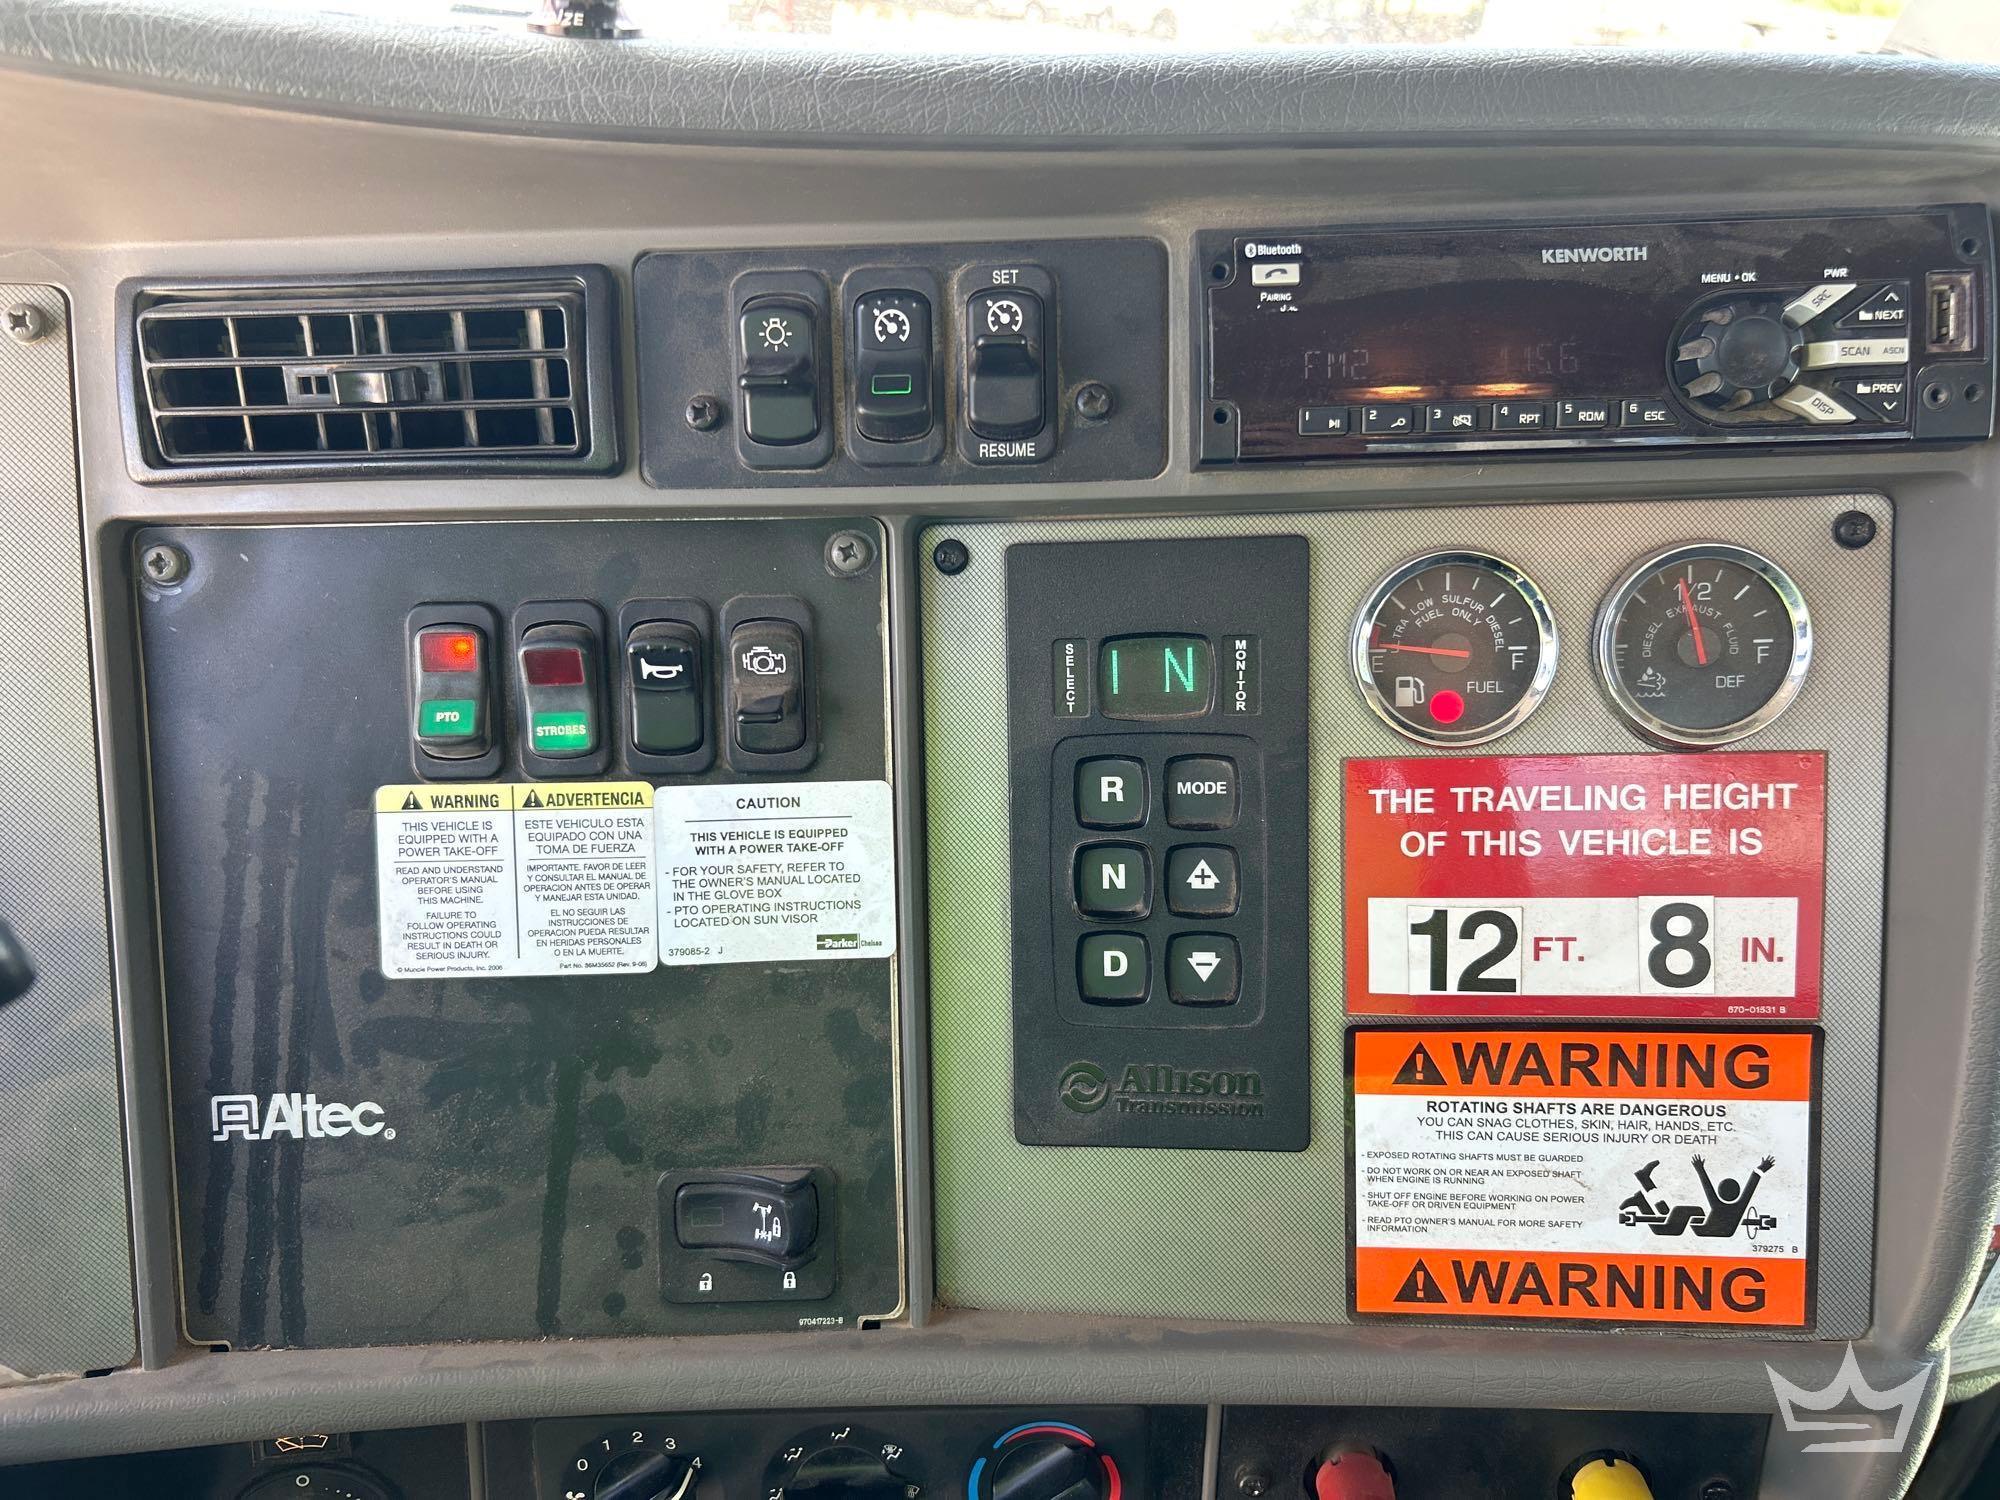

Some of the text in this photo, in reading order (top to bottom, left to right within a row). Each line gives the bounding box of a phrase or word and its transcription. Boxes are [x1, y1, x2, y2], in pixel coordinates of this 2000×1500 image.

[1257, 244, 1302, 256] Bluetooth
[1541, 247, 1648, 264] KENWORTH
[992, 269, 1019, 284] SET
[1701, 272, 1756, 284] MENU OK
[1823, 268, 1849, 278] PWR
[1811, 289, 1832, 308] SRC
[1874, 309, 1905, 320] NEXT
[1840, 347, 1871, 356] SCAN
[1304, 350, 1369, 380] FM2
[1872, 383, 1902, 393] PREV
[1565, 404, 1605, 421] 5 RDM
[1629, 403, 1665, 421] 6 ESC
[1811, 397, 1835, 415] DISP
[1305, 411, 1309, 421] 1
[1369, 411, 1378, 420] 2
[1434, 409, 1441, 419] 3
[1500, 406, 1541, 424] 4 RPT
[979, 443, 1036, 458] RESUME
[1673, 582, 1711, 601] 1/2
[1410, 598, 1434, 615] LOW
[1441, 594, 1485, 614] SULFUR
[1485, 615, 1504, 652] DIESEL
[1415, 608, 1482, 628] FUEL ONLY
[1642, 622, 1663, 657] DIESEL
[1722, 622, 1739, 655] FLUID
[1512, 653, 1524, 670] F
[1757, 646, 1769, 664] F
[1164, 647, 1194, 692] N
[1372, 655, 1384, 673] E
[1065, 643, 1076, 713] SELECT
[1235, 639, 1247, 711] MONITOR
[1715, 675, 1745, 688] DEF
[1466, 681, 1504, 693] FUEL
[435, 710, 460, 722] PTO
[536, 724, 587, 737] STROBES
[1101, 776, 1124, 802] R
[1177, 781, 1227, 795] MODE
[430, 794, 498, 808] WARNING
[545, 792, 644, 806] ADVERTENCIA
[736, 796, 800, 809] CAUTION
[1368, 783, 1798, 813] THE TRAVELING HEIGHT
[401, 820, 492, 831] THIS VEHICLE IS
[524, 818, 644, 829] ESTE VEHICULO ESTA
[398, 833, 498, 844] EQUIPPED WITH A
[527, 830, 642, 841] EQUIPADO CON UNA
[689, 828, 848, 841] THIS VEHICLE IS EQUIPPED
[1400, 827, 1762, 856] OF THIS VEHICLE IS
[398, 846, 497, 856] POWER TAKE-OFF
[535, 843, 635, 854] TOMA DE FUERZA
[694, 841, 843, 855] WITH A POWER TAKE-OFF
[395, 865, 503, 874] READ AND UNDERSTAND
[672, 861, 844, 876] FOR YOUR SAFETY, REFER TO
[671, 873, 860, 888] THE OWNER'S MANUAL LOCATED
[1102, 863, 1126, 890] N
[673, 888, 782, 901] IN THE GLOVE BOX
[825, 938, 857, 948] Parker
[1410, 902, 1784, 993] 12 FT. 8 IN.
[668, 946, 722, 956] 379085-2 J
[1104, 951, 1128, 977] D
[1779, 1005, 1786, 1014] B
[1451, 1042, 1769, 1088] WARNING
[1114, 1064, 1264, 1096] Allison
[1114, 1096, 1264, 1117] Transmission
[1426, 1100, 1726, 1116] ROTATING SHAFTS ARE DANGEROUS
[1416, 1116, 1736, 1132] YOU CAN SNAG CLOTHES, SKIN, HAIR, HANDS, ETC.
[1435, 1130, 1716, 1144] THIS CAN CAUSE SERIOUS INJURY OR DEATH
[1366, 1151, 1409, 1159] EXPOSED
[1411, 1151, 1456, 1159] ROTATING
[1458, 1152, 1493, 1160] SHAFTS
[1496, 1153, 1521, 1161] MUST
[1538, 1154, 1583, 1162] GUARDED
[1752, 1244, 1798, 1253] 379275 B
[1451, 1261, 1765, 1311] WARNING
[799, 1316, 844, 1326] 970417223-B
[577, 1431, 702, 1471] 0 1 2 3 4
